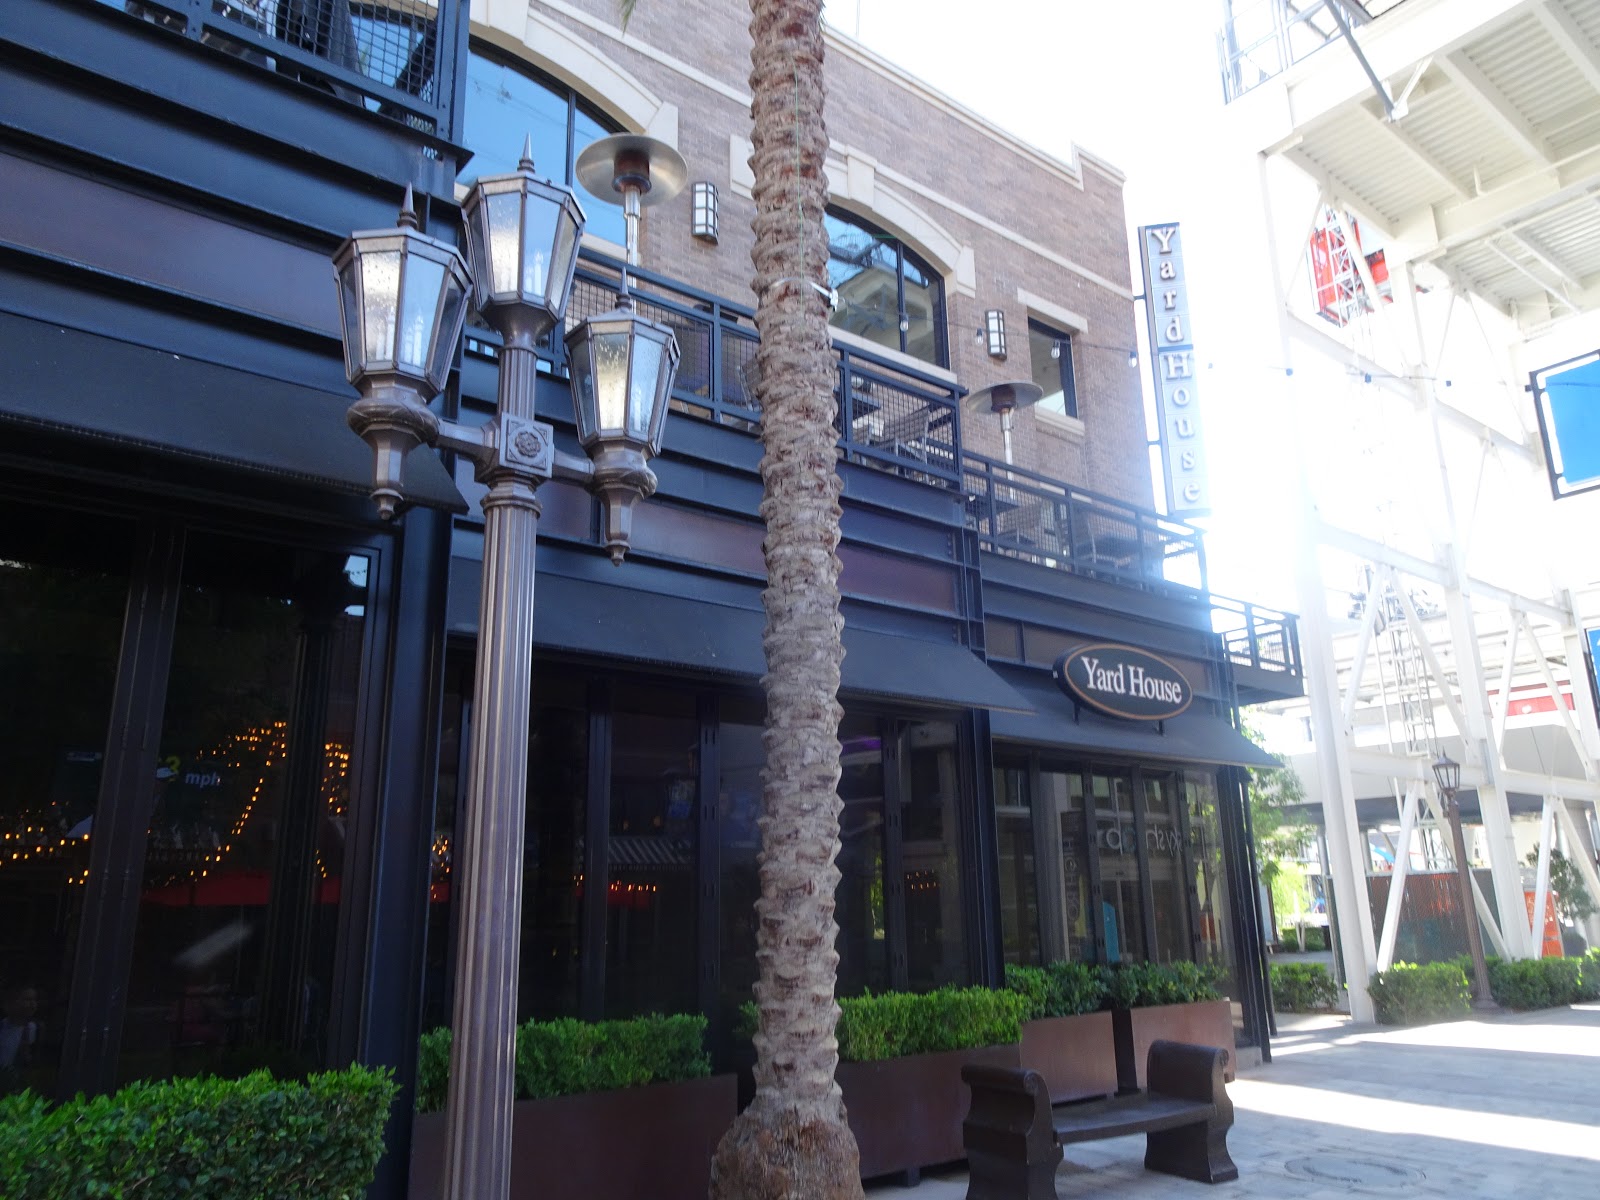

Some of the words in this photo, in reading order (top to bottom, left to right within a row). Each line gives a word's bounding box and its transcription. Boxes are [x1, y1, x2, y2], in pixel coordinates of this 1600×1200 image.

[1151, 227, 1185, 344] Yard
[1163, 352, 1200, 503] House
[1080, 656, 1126, 694] Yard
[1127, 665, 1182, 704] House
[185, 772, 220, 788] mph
